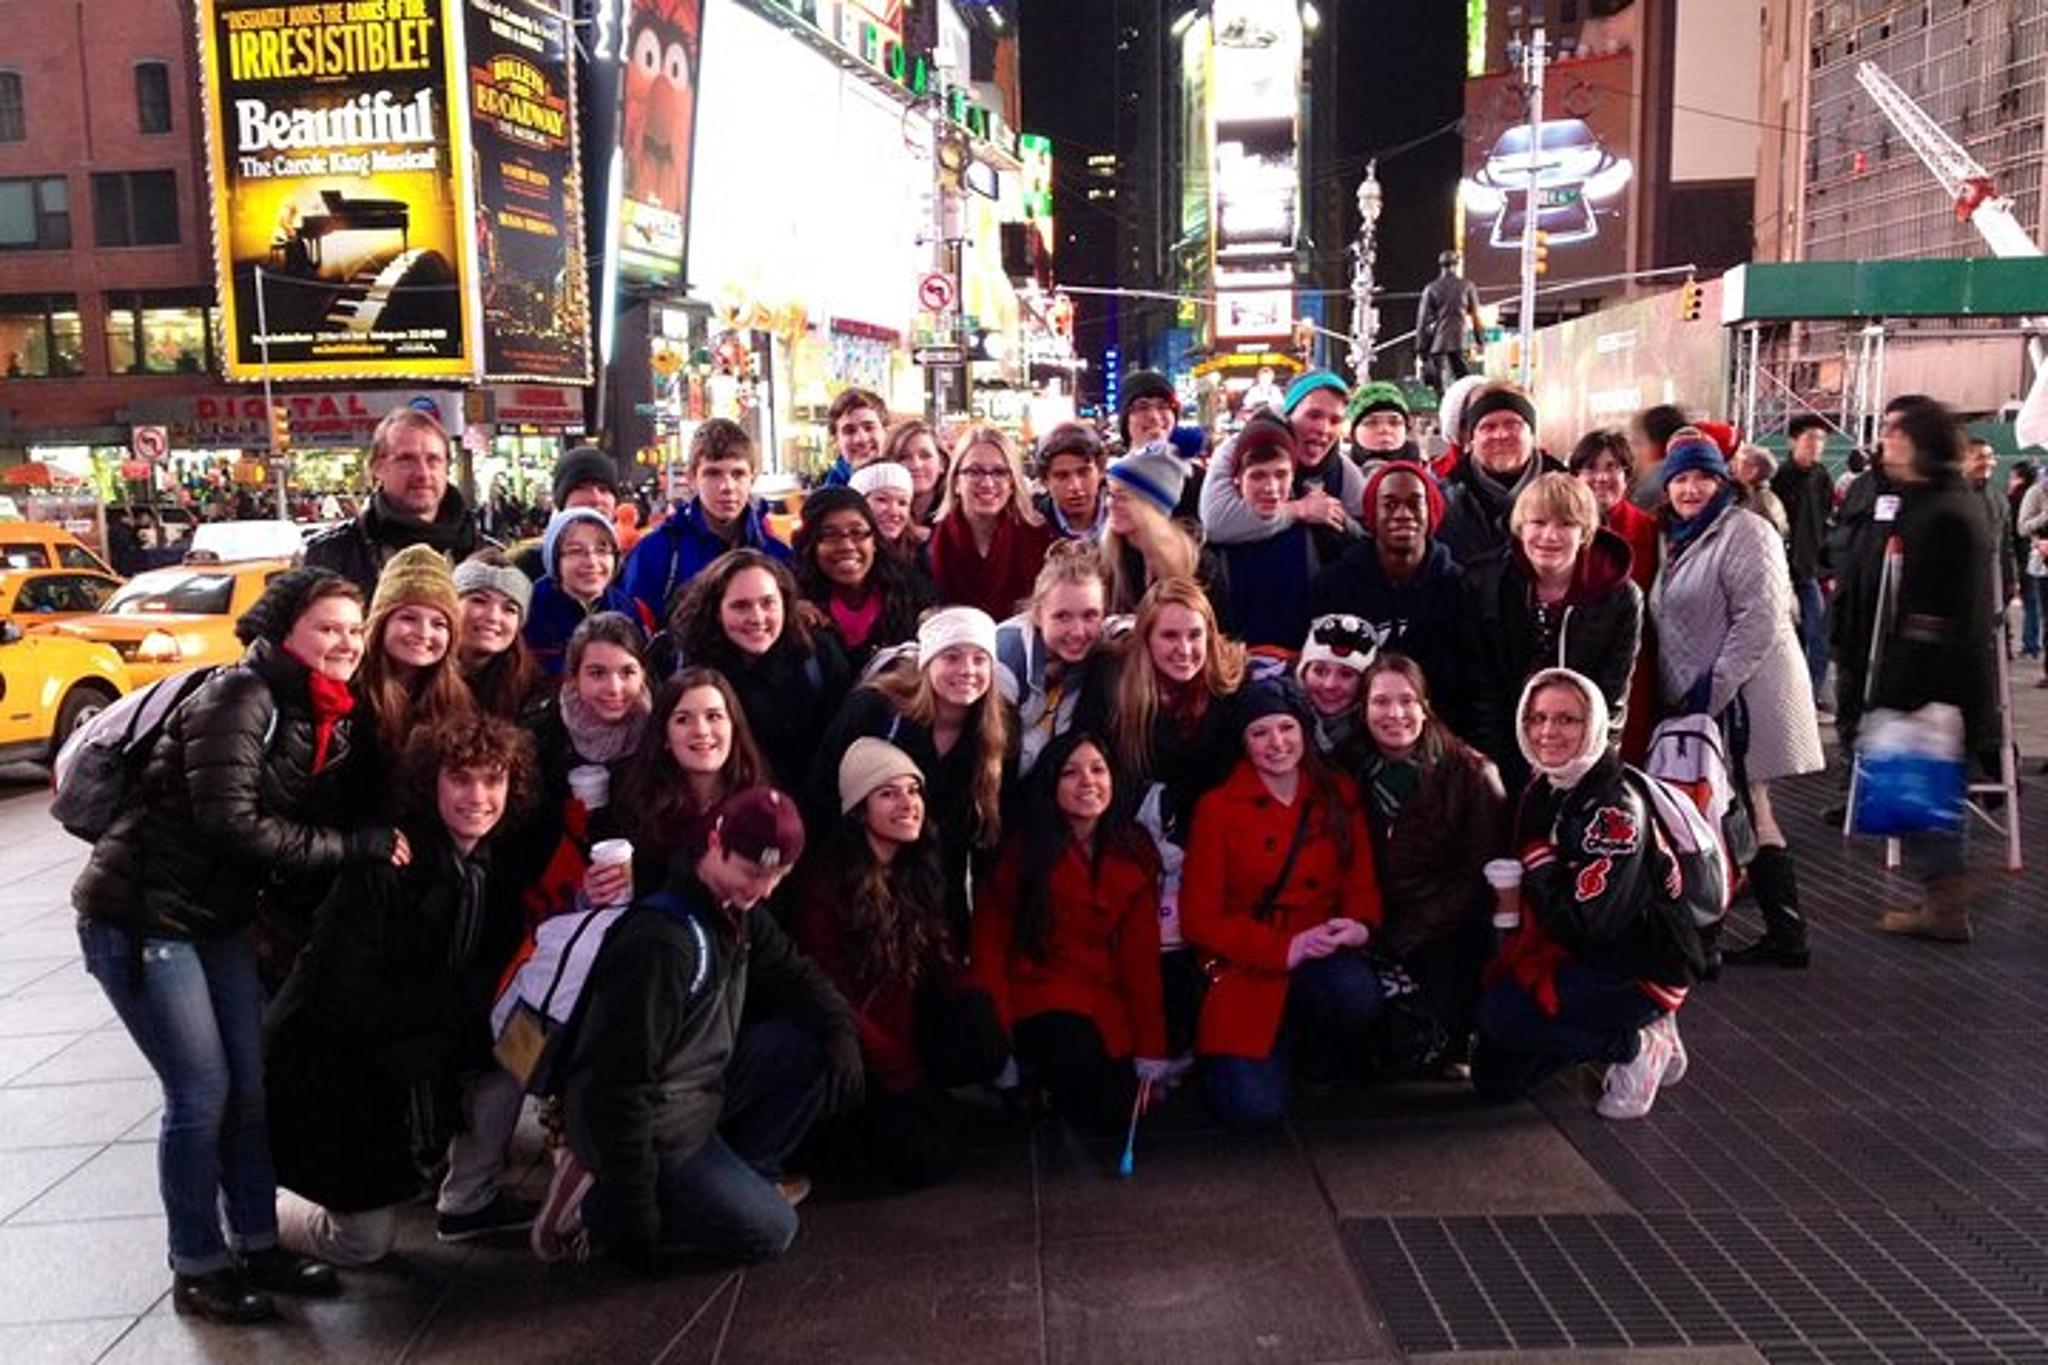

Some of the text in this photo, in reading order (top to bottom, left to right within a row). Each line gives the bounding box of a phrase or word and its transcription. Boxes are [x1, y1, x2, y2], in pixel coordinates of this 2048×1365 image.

[235, 87, 434, 151] Beautiful
[476, 84, 565, 137] BROADWAY
[238, 147, 436, 178] The Carole King Musical
